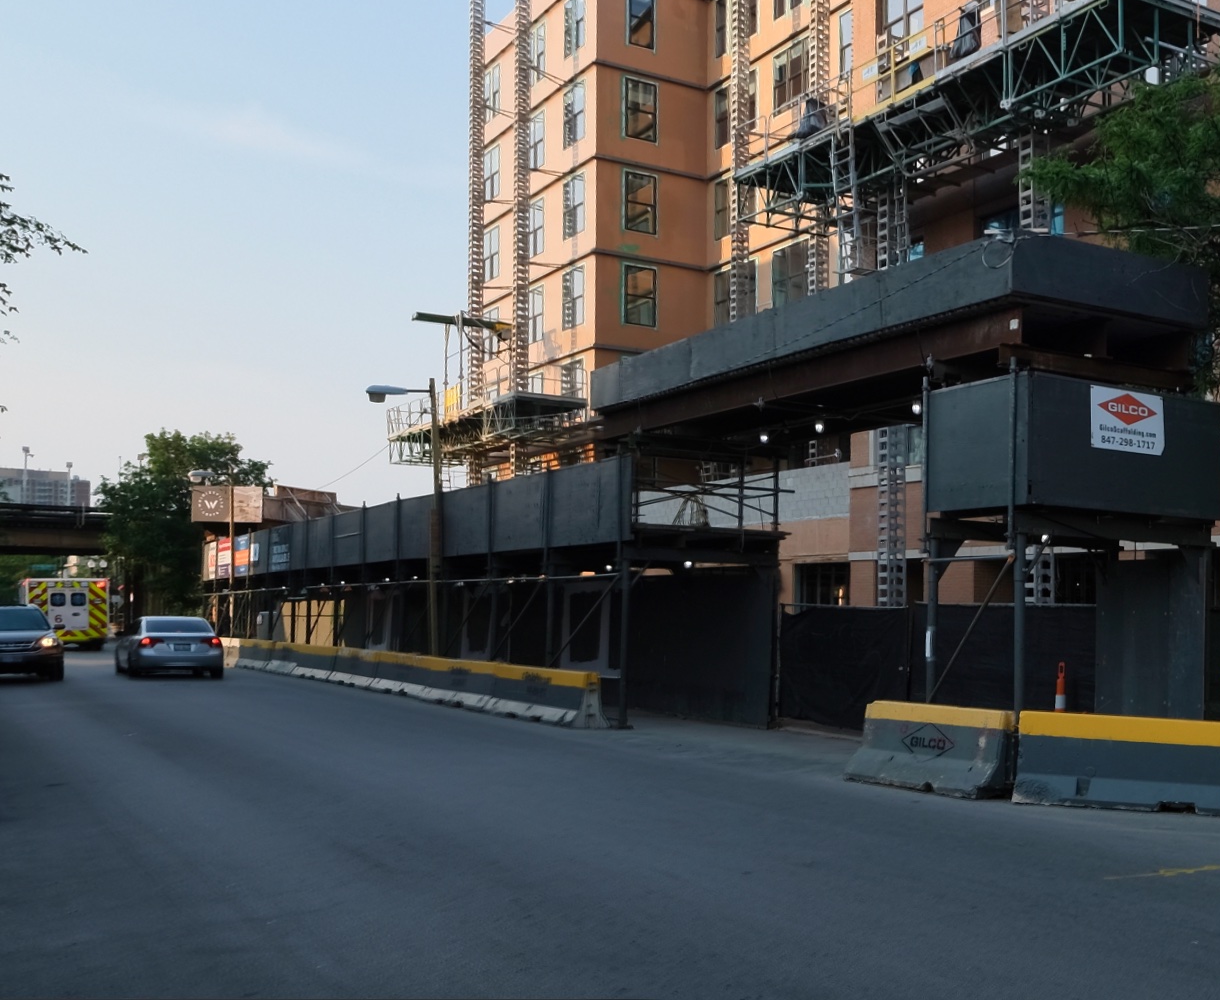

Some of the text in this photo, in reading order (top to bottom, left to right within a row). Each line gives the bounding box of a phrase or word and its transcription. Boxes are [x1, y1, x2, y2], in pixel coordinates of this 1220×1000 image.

[1108, 402, 1148, 417] GILCO
[1099, 424, 1157, 438] GilcoScaffolding.com
[1101, 435, 1156, 450] 847-298-1717
[204, 500, 218, 509] W
[54, 614, 63, 623] 6
[910, 736, 946, 750] GILCO
